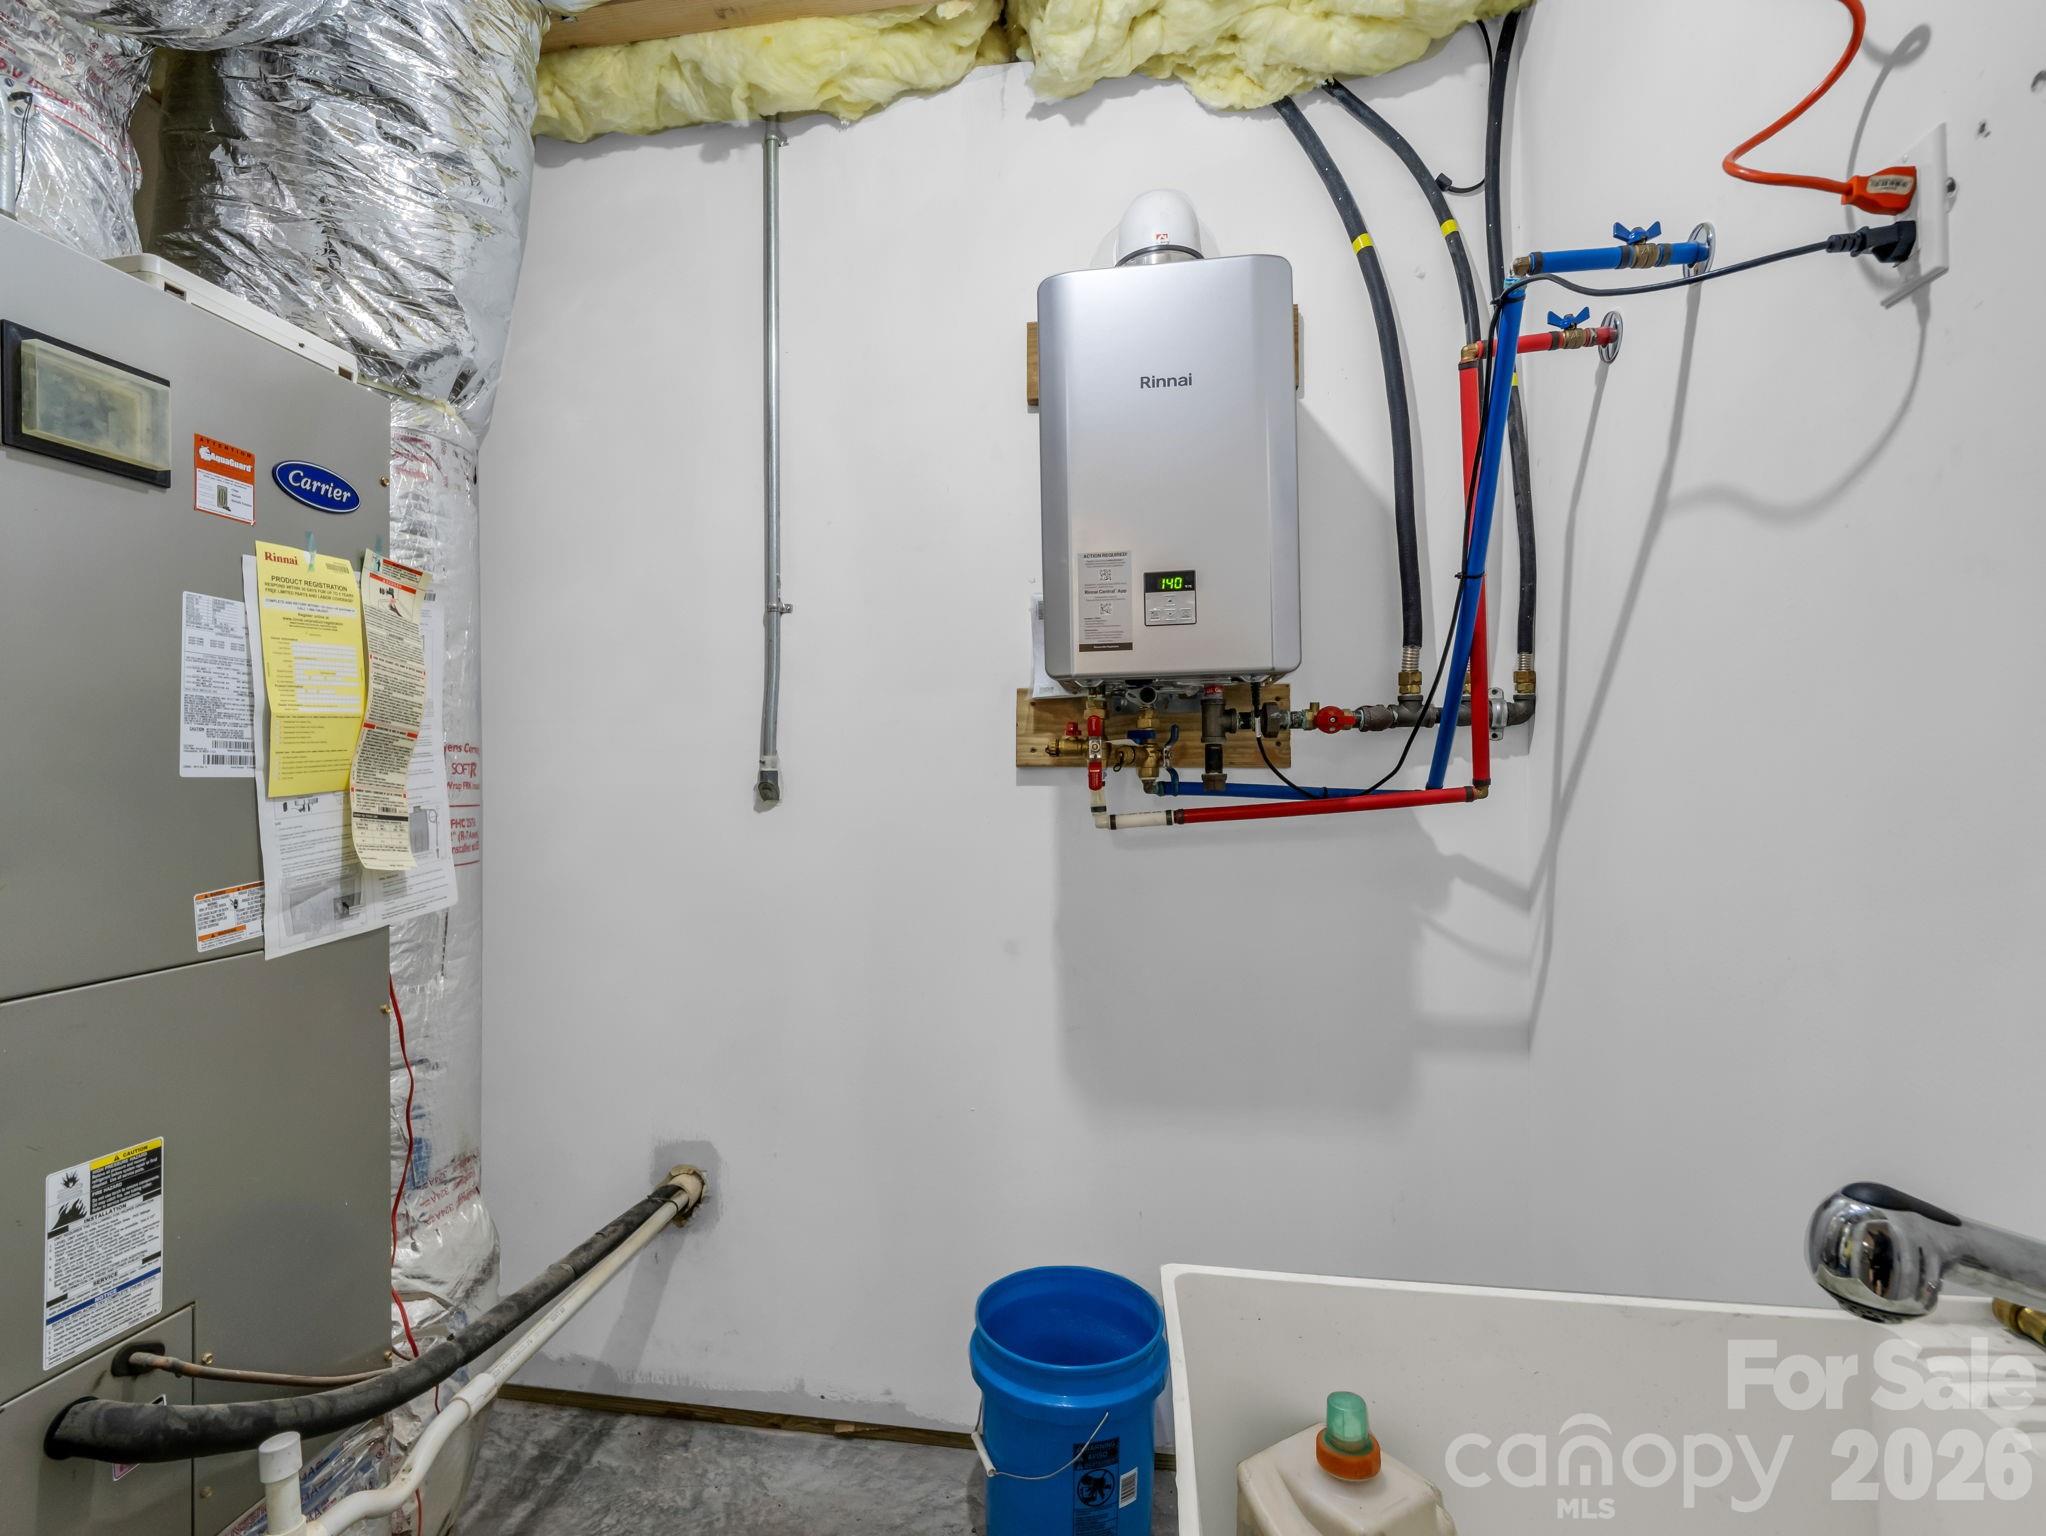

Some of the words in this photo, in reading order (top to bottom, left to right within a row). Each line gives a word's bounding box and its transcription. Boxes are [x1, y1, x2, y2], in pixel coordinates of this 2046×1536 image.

[1140, 373, 1192, 389] Rinnai
[288, 470, 351, 503] Carrier
[264, 551, 298, 566] Rinnai
[271, 575, 302, 586] PRODUCT
[304, 578, 348, 592] REGISTRATION
[1162, 577, 1182, 590] 140
[123, 1145, 148, 1158] CAUTION
[84, 1202, 126, 1224] INSTALLATION
[93, 1271, 117, 1286] SERVICE
[94, 1288, 116, 1302] NOTICE
